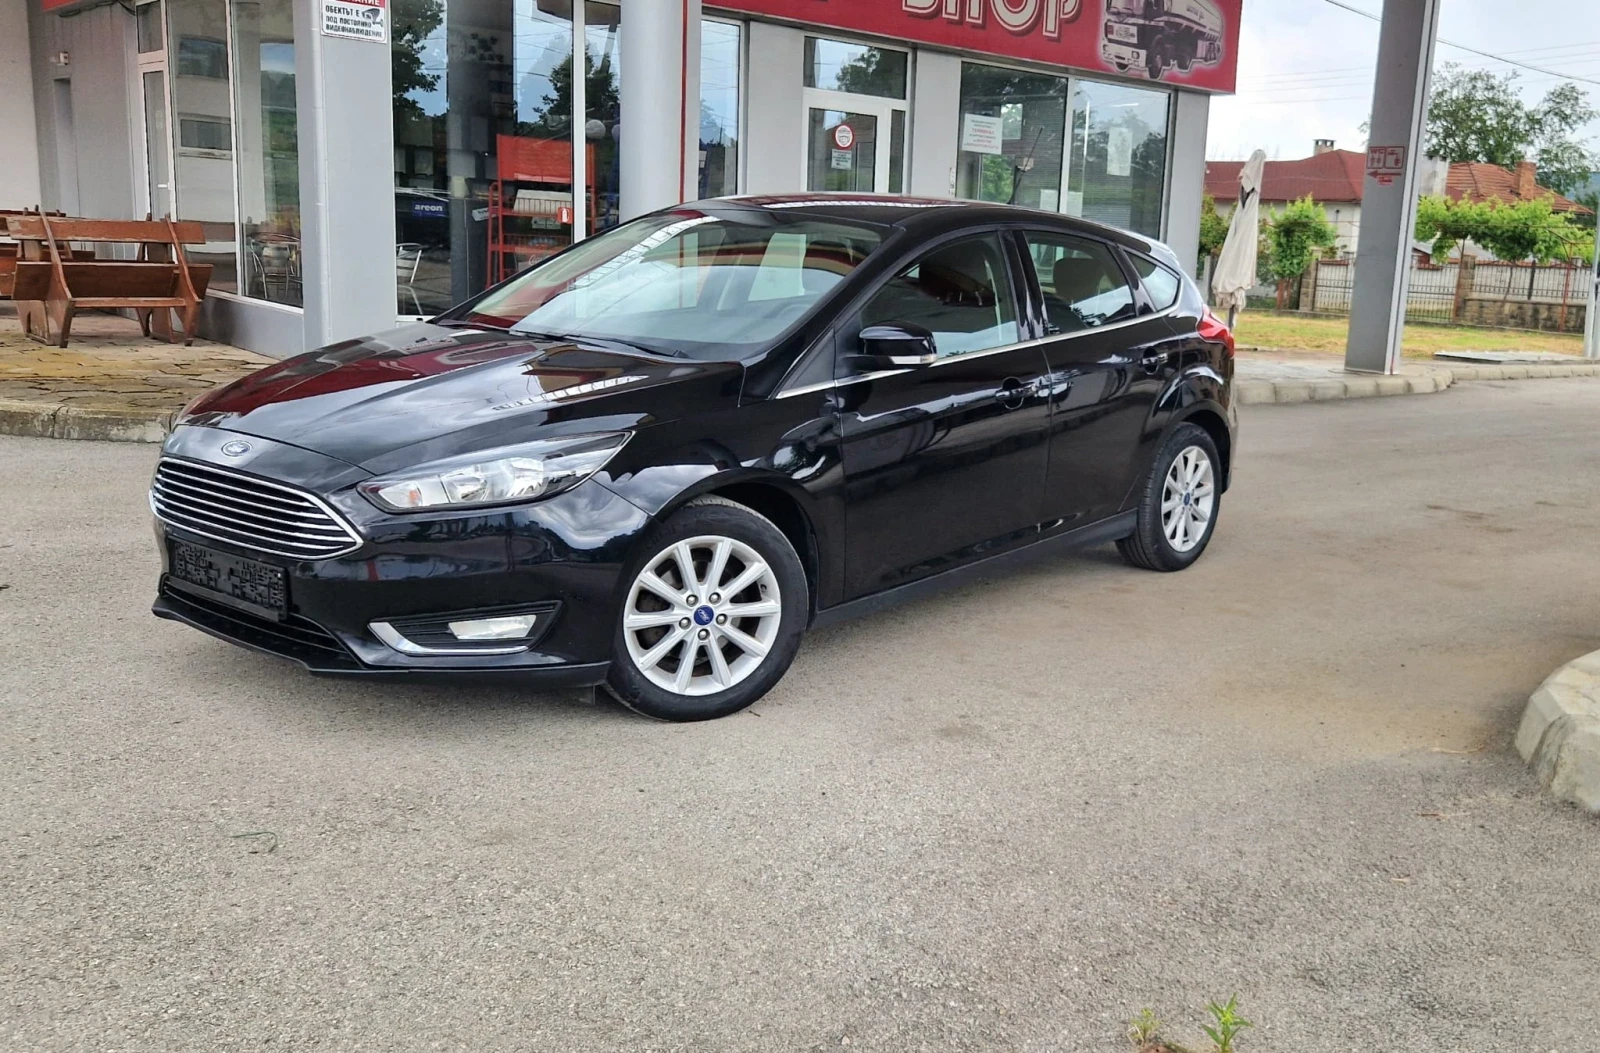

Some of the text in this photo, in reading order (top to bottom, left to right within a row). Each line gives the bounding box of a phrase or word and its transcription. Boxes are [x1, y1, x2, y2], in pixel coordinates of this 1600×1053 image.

[326, 5, 360, 17] ОБЕКТЪТ Е
[326, 15, 372, 28] ПОД ПОСТОЯННО
[326, 24, 382, 37] ВИДЕОНАБЛЮДЕНИЕ
[414, 203, 443, 212] areon
